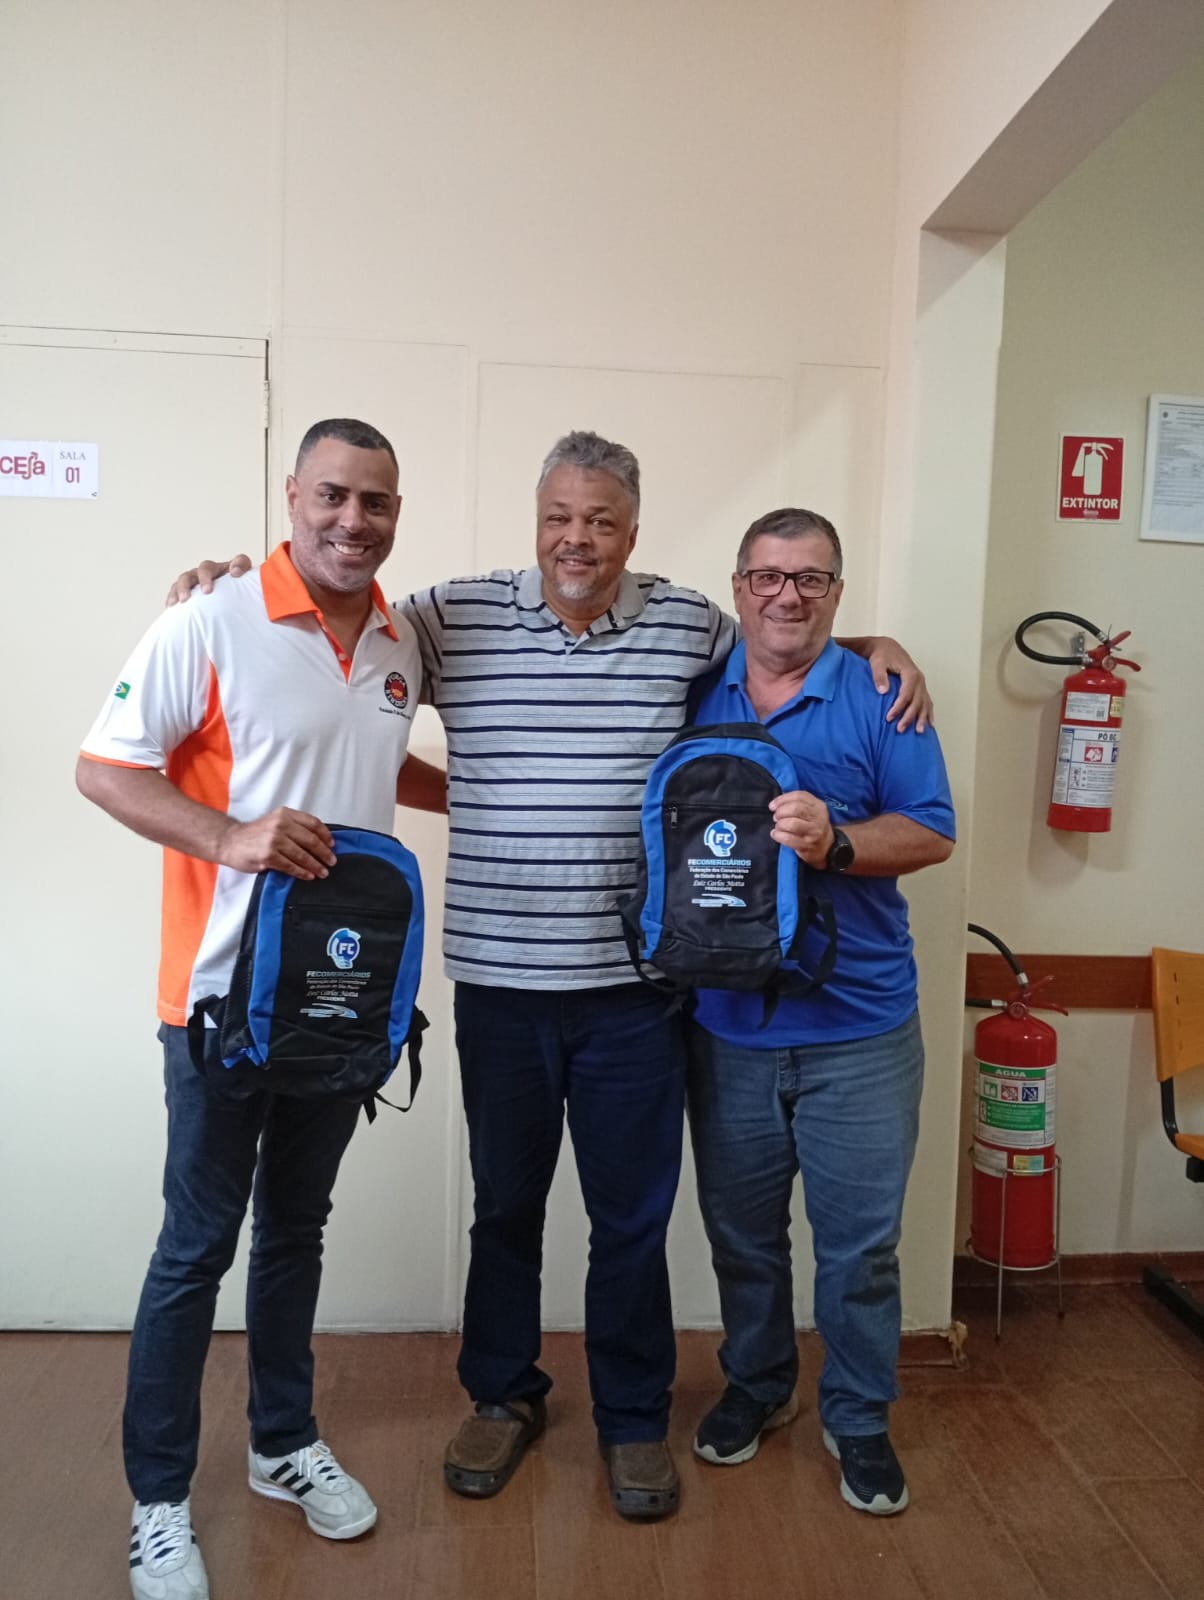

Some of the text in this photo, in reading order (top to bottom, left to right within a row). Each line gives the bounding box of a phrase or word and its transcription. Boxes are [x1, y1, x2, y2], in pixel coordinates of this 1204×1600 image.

[59, 451, 86, 460] SALA
[65, 466, 80, 483] 01
[1062, 497, 1119, 509] EXTINTOR
[715, 833, 732, 844] FC
[338, 942, 355, 955] FC
